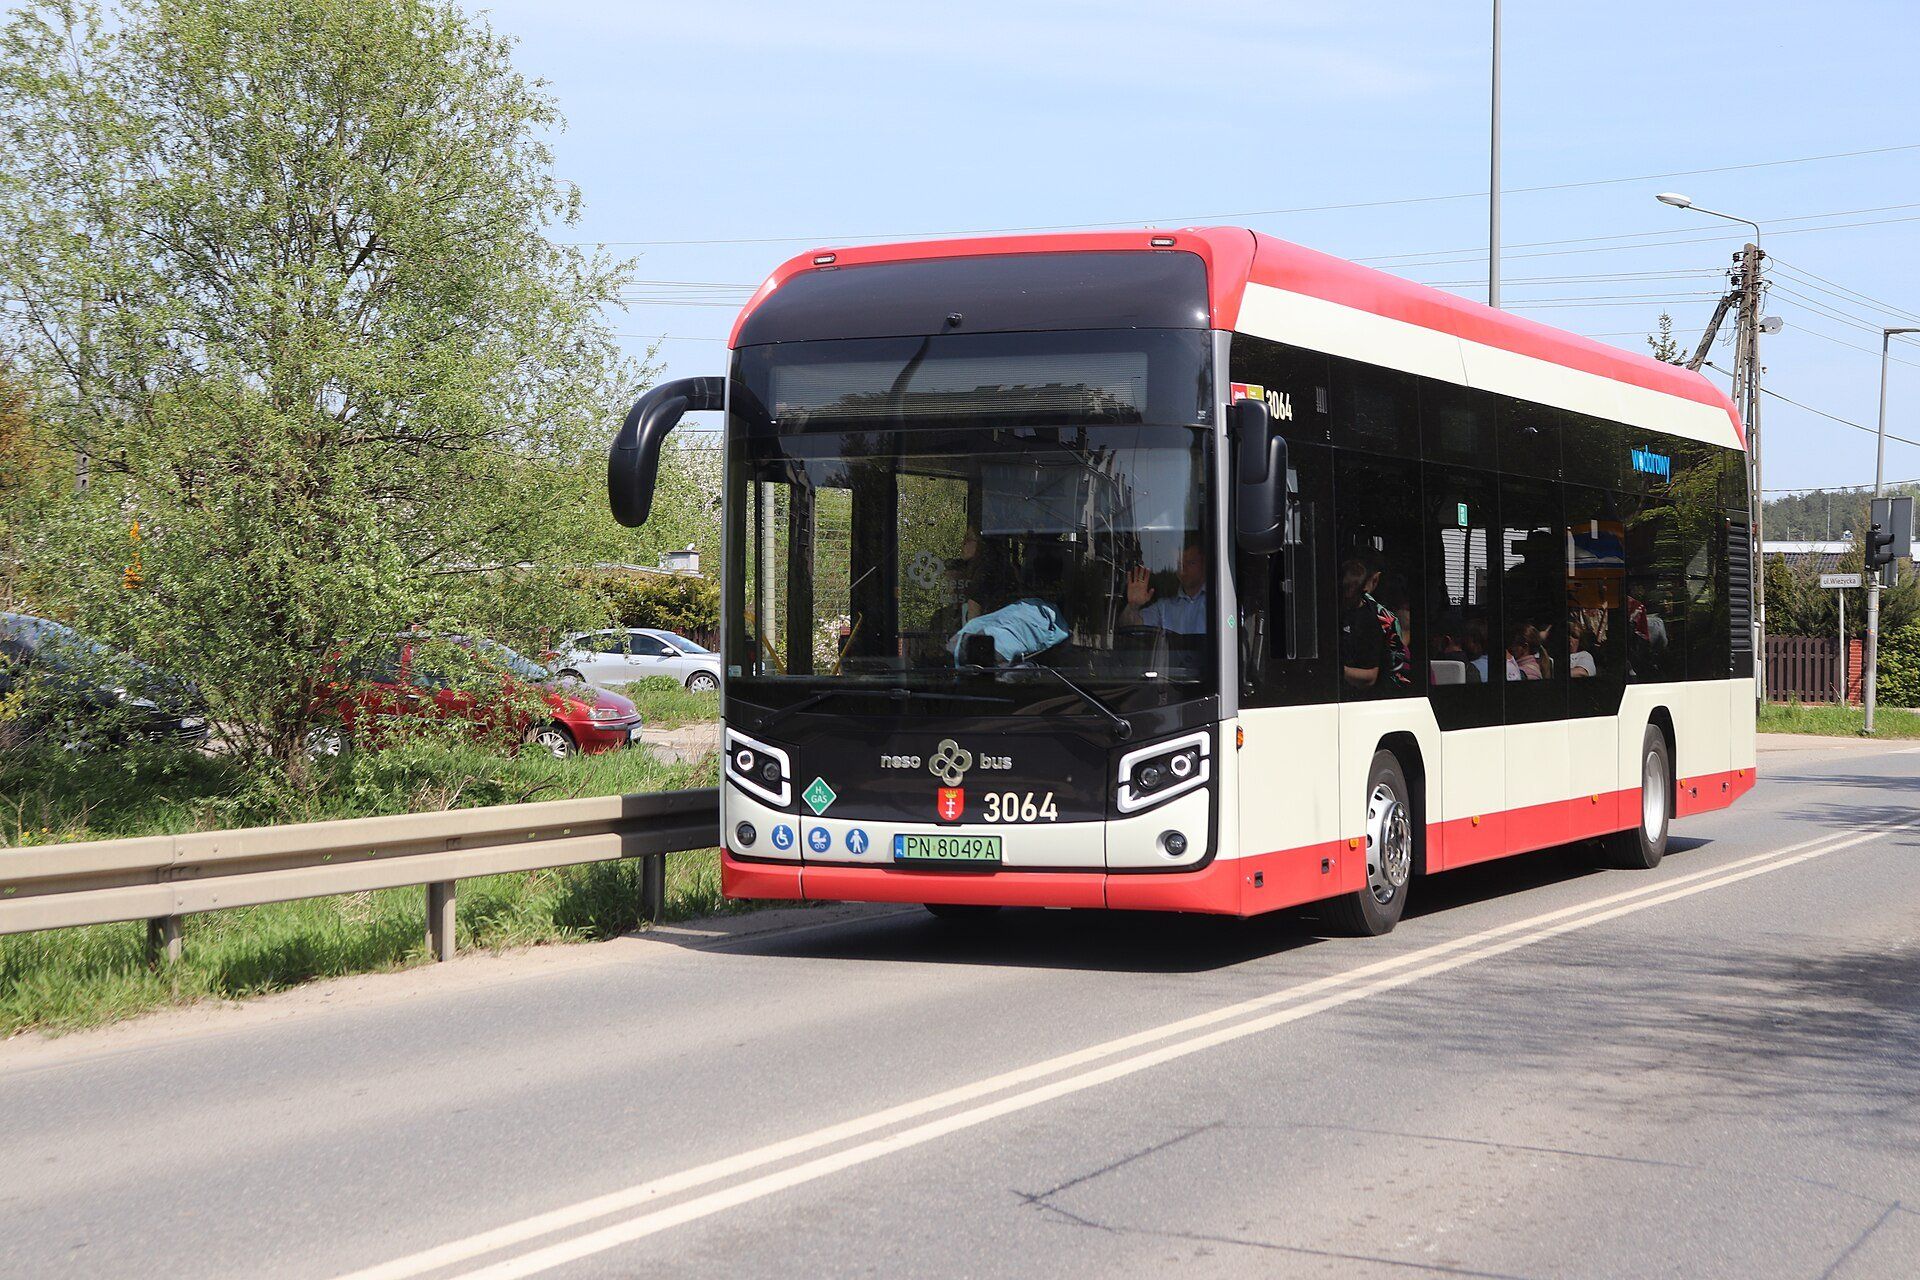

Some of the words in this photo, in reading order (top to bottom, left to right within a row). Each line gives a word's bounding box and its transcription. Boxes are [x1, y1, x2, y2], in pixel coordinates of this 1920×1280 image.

[1265, 389, 1293, 421] 3064
[880, 755, 921, 769] neso
[980, 753, 1013, 769] bus
[810, 794, 828, 804] GAS
[983, 792, 1058, 822] 3064
[907, 837, 931, 857] PN
[938, 839, 996, 859] 8049A
